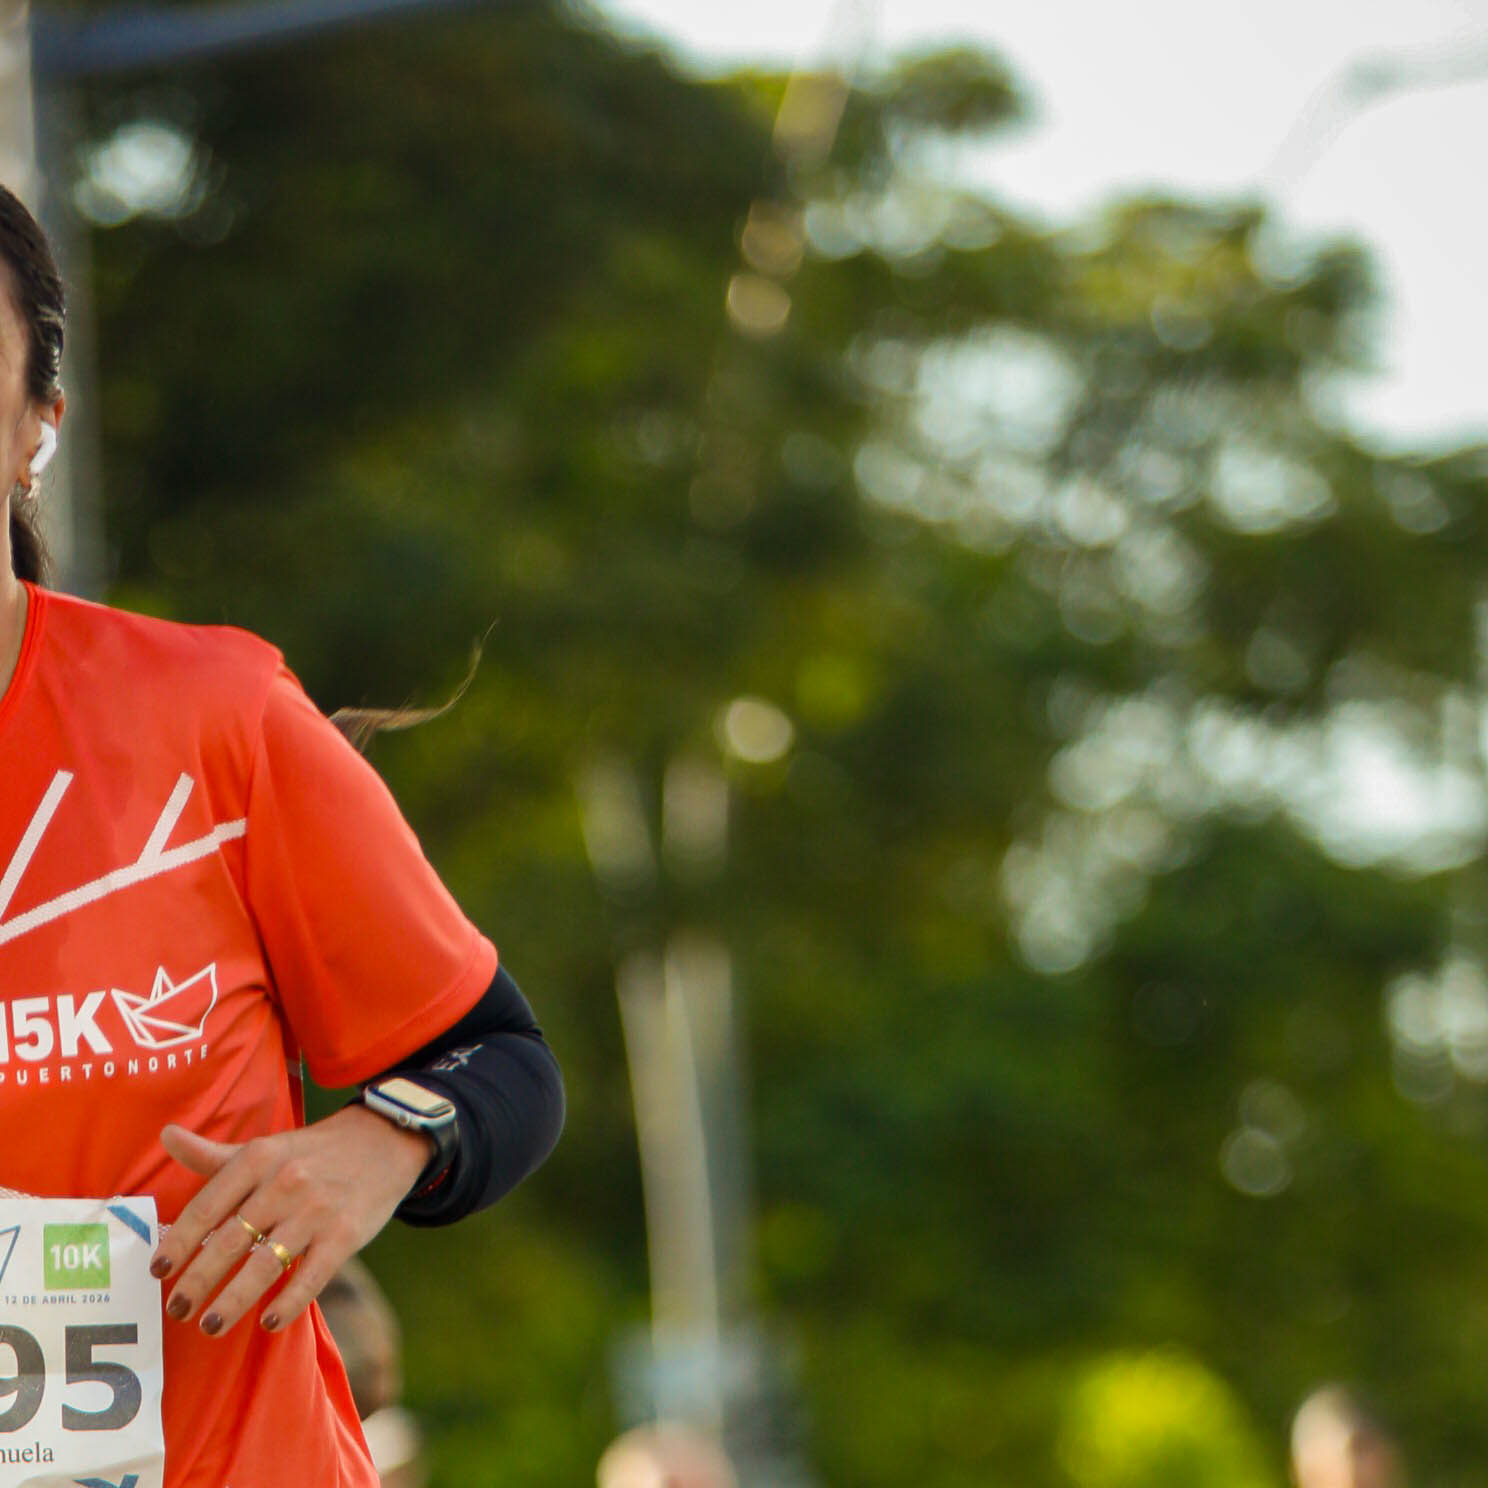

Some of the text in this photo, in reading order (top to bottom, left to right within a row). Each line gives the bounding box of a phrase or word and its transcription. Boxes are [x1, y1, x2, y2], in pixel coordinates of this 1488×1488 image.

[50, 1243, 104, 1271] 10K
[5, 1295, 18, 1305] 12
[22, 1295, 37, 1305] DE
[41, 1295, 77, 1305] ABRIL
[81, 1294, 111, 1304] 2026
